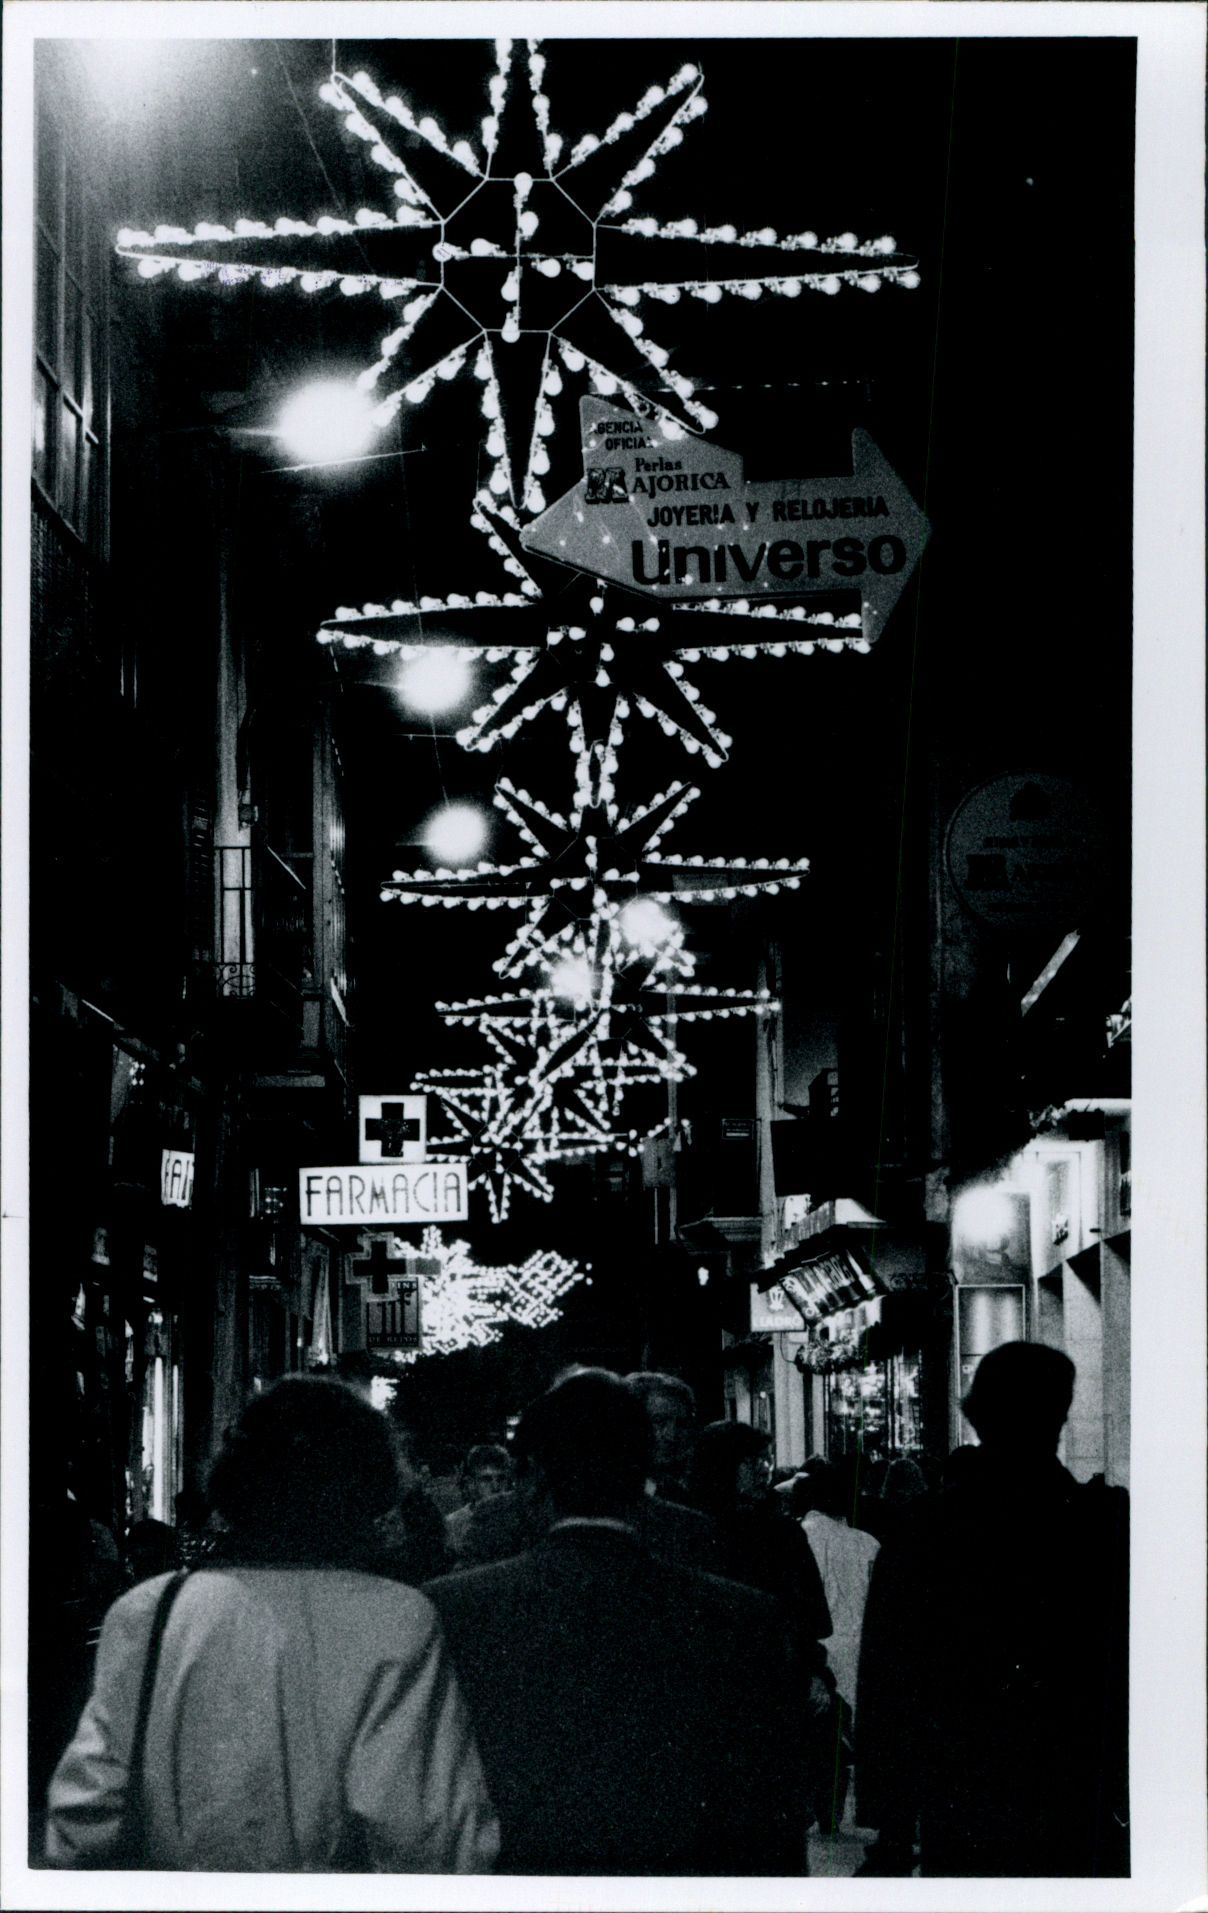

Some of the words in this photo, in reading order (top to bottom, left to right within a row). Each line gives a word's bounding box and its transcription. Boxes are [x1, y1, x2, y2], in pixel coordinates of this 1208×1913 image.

[634, 456, 683, 472] Perlas
[647, 503, 735, 527] JOYERIA
[748, 501, 760, 522] Y
[773, 496, 890, 521] RELOJERIA
[306, 1172, 462, 1216] FARMACIA
